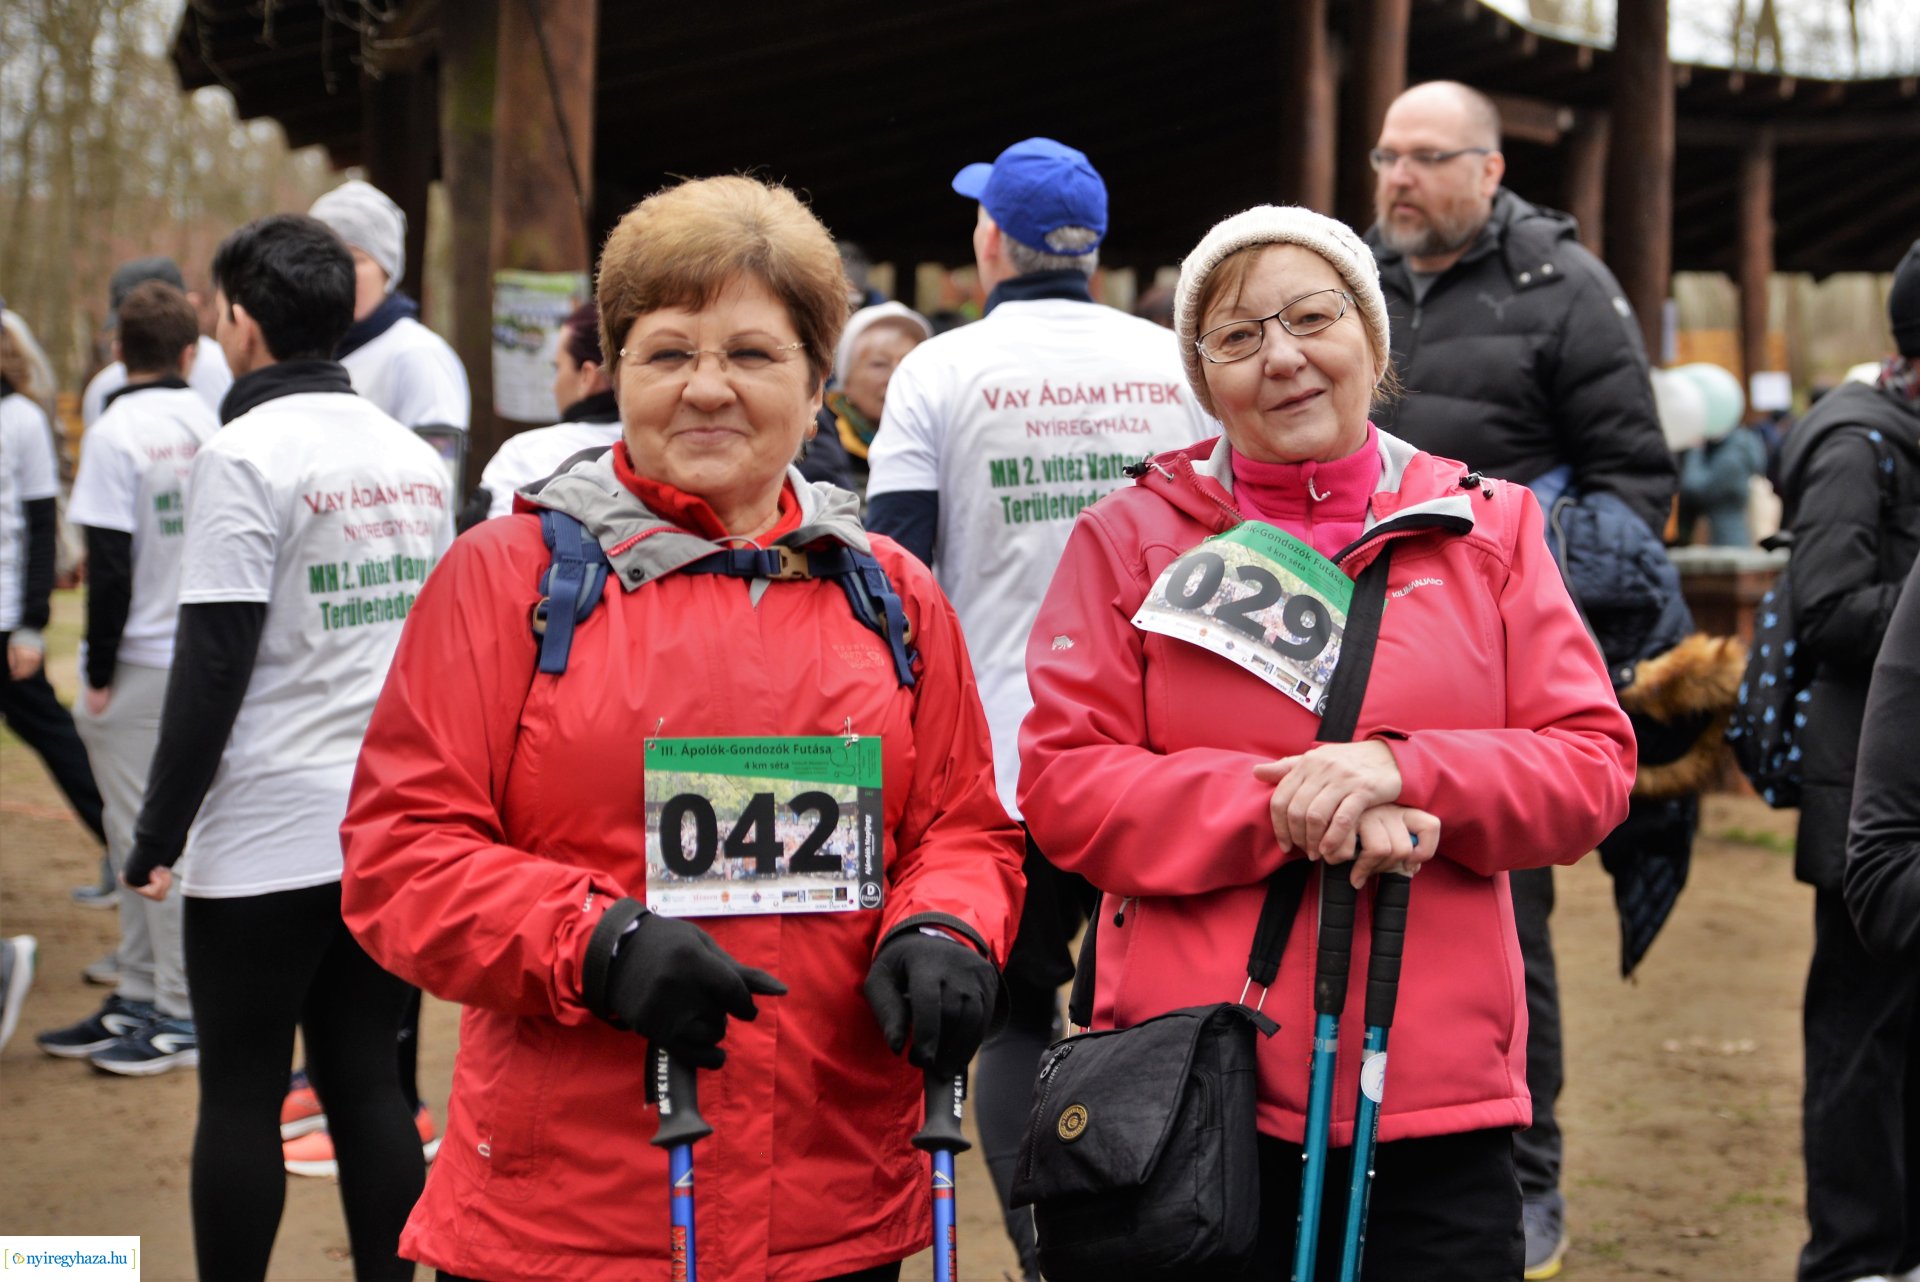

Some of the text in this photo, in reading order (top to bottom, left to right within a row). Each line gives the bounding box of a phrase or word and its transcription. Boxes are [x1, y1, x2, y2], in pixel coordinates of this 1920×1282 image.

[982, 379, 1184, 411] VAY ÁDÁM HTBK
[1025, 415, 1151, 438] NYÍREGYHÁZA
[989, 452, 1143, 488] MH 2. vitéz Vatta
[1273, 548, 1287, 560] km
[1289, 558, 1306, 572] séta
[1314, 558, 1344, 586] Futása
[308, 563, 339, 594] MH
[342, 561, 355, 591] 2.
[1165, 552, 1332, 661] 029
[661, 742, 832, 759] III. Ápolók-Gondozók Futása
[744, 761, 750, 770] 4
[752, 761, 767, 770] km
[770, 761, 790, 770] séta
[660, 790, 842, 877] 042
[866, 884, 875, 896] D
[657, 1048, 671, 1115] McKINL
